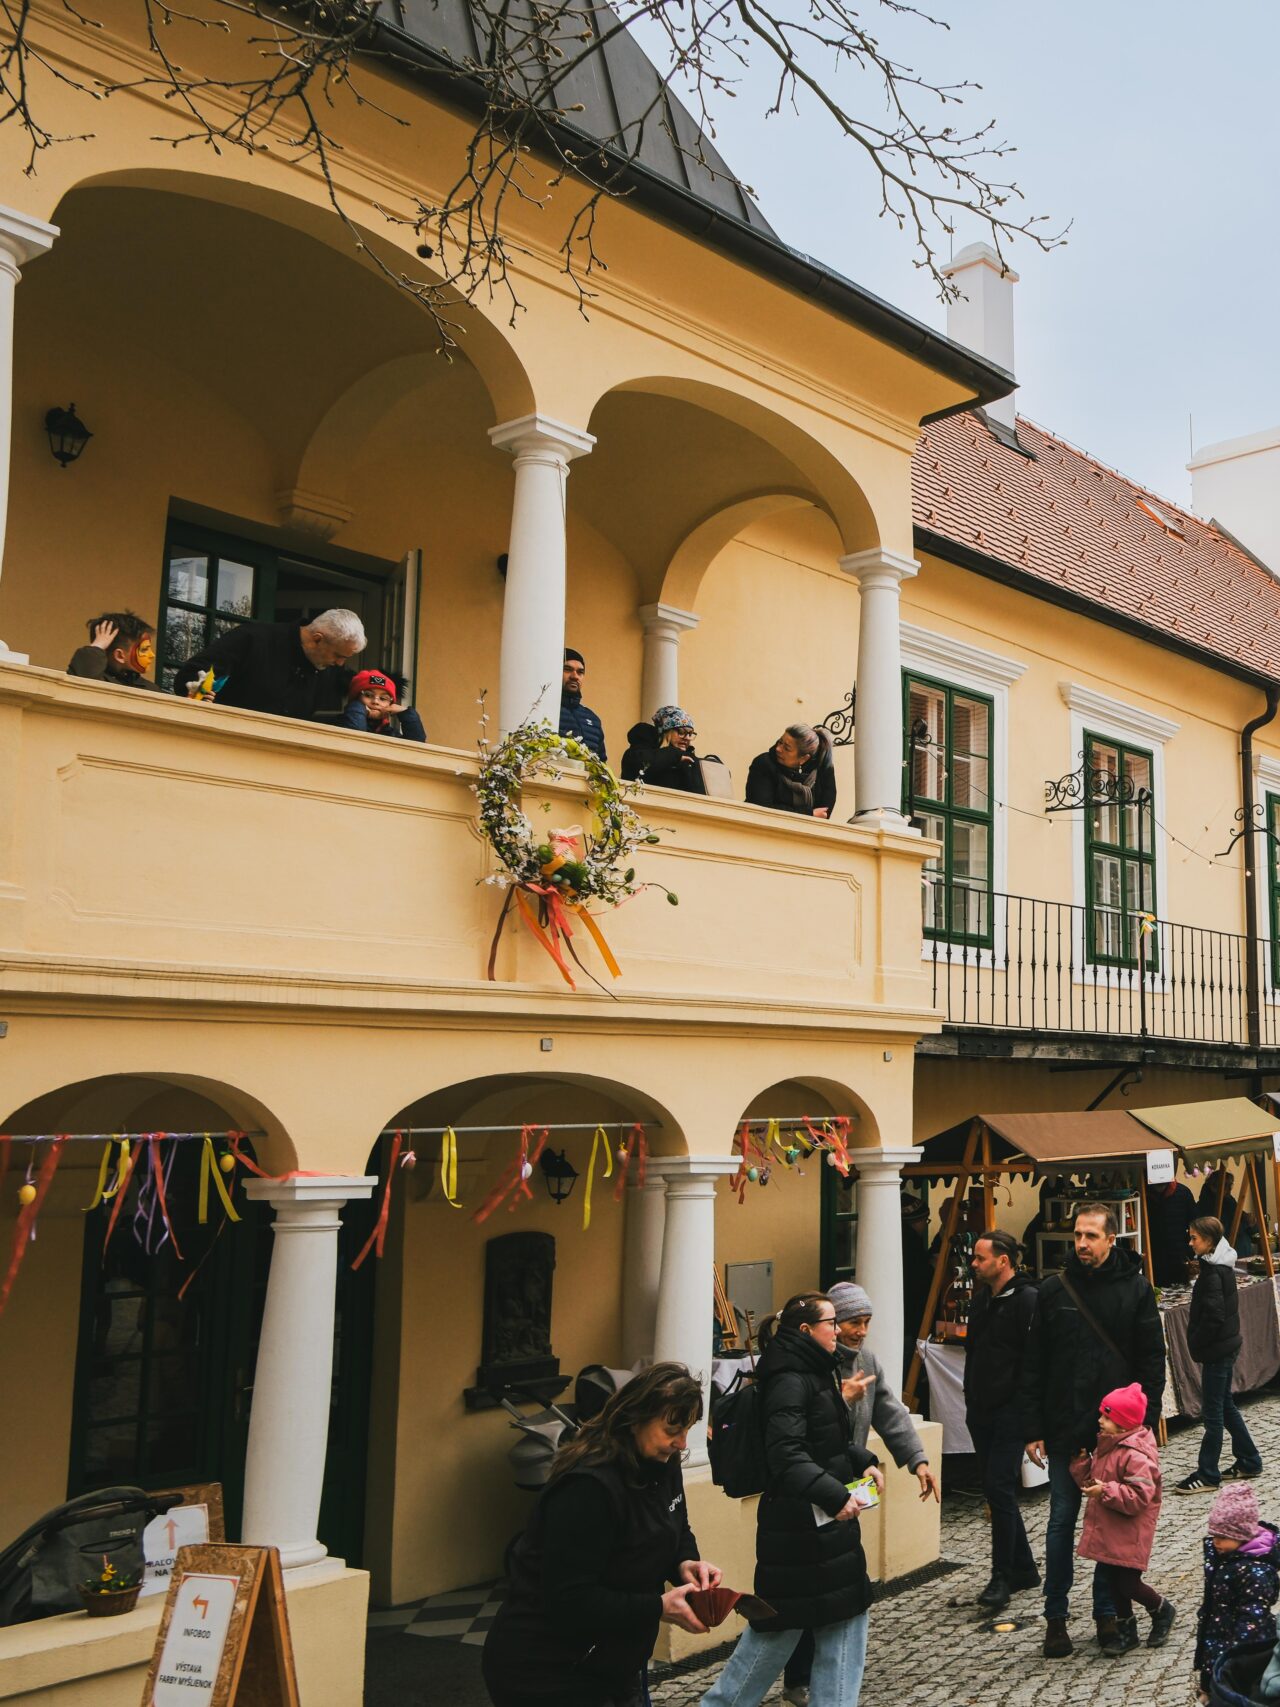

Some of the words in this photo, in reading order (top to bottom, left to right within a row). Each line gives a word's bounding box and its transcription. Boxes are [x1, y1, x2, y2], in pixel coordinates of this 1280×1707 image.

[154, 1568, 169, 1577] NA
[183, 1628, 212, 1639] INFOBOD
[175, 1660, 202, 1674] VÝSTAVA
[159, 1674, 177, 1685] FARBY
[177, 1676, 213, 1689] MYŠLIENOK
